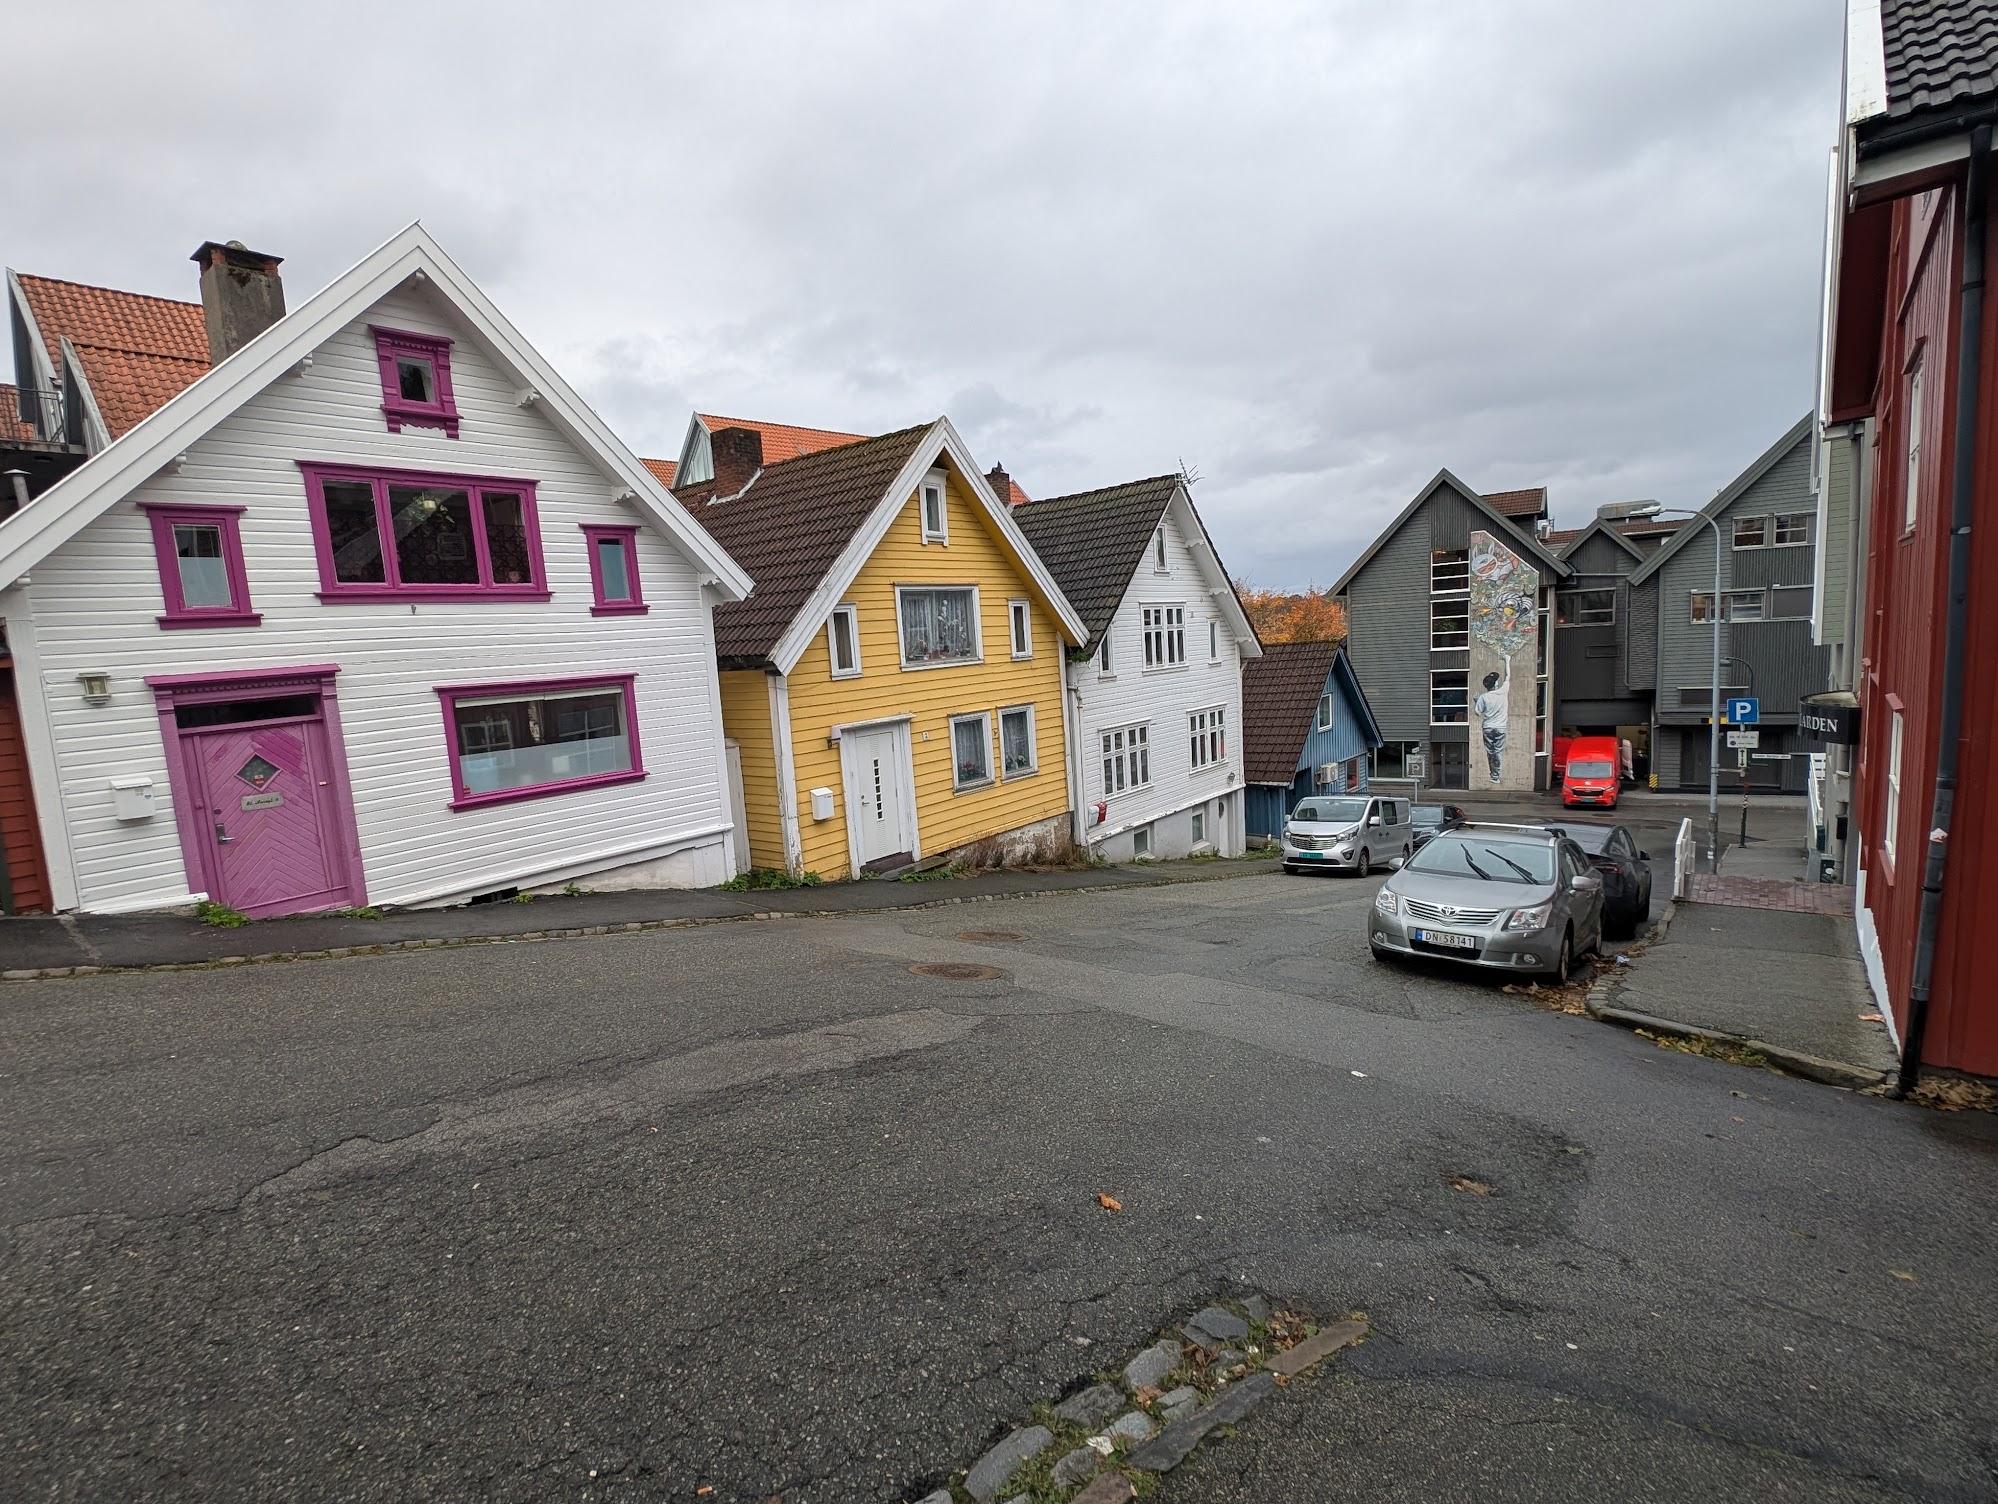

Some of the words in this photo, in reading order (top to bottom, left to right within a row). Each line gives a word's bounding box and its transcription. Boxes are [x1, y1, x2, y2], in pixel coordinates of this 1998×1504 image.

[1735, 701, 1752, 721] P
[1799, 713, 1838, 733] ARDEN
[1425, 931, 1439, 942] DN
[1443, 934, 1473, 947] 58141
